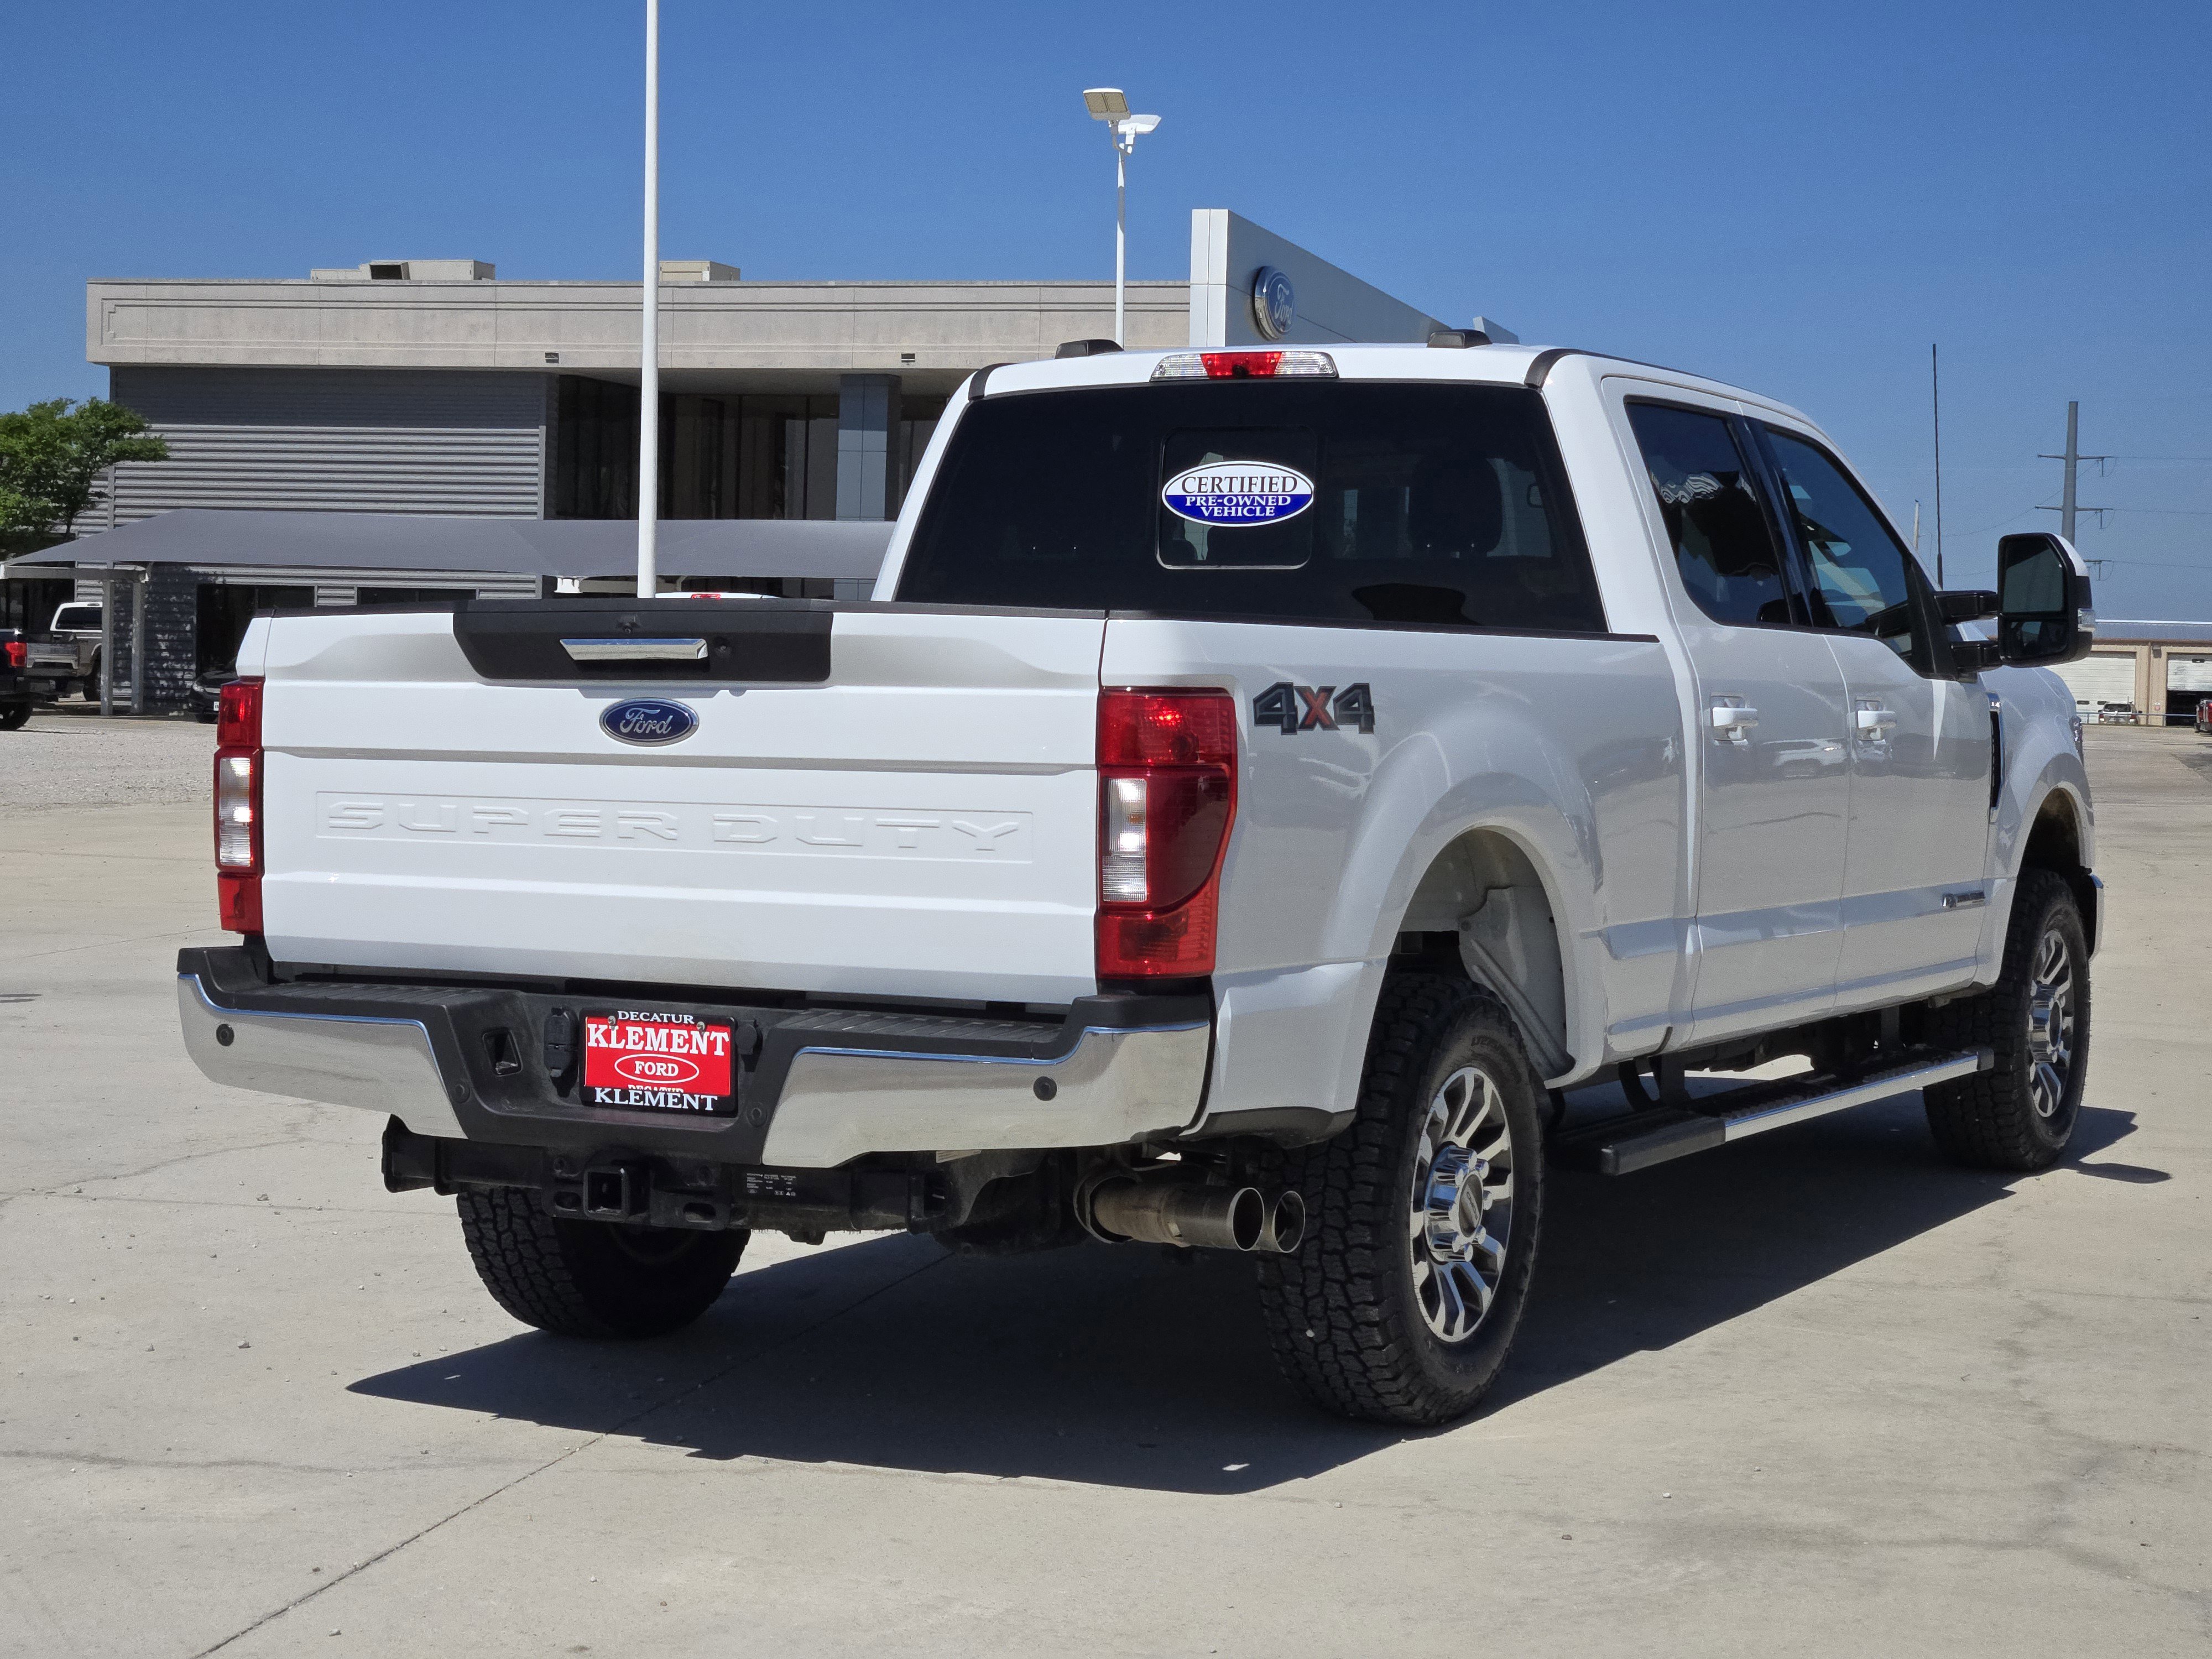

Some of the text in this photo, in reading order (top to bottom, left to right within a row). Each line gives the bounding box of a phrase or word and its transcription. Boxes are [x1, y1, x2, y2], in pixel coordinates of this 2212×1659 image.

[1181, 476, 1297, 494] CERTIFIED
[1185, 495, 1291, 507] PRE-OWNED
[1201, 506, 1275, 517] VEHICLE
[619, 707, 674, 734] Ford
[328, 801, 1019, 852] SUPER DUTY
[617, 1011, 695, 1024] DECATUR
[587, 1023, 729, 1056] KLEMENT
[634, 1061, 679, 1077] FORD
[594, 1087, 718, 1111] KLEMENT
